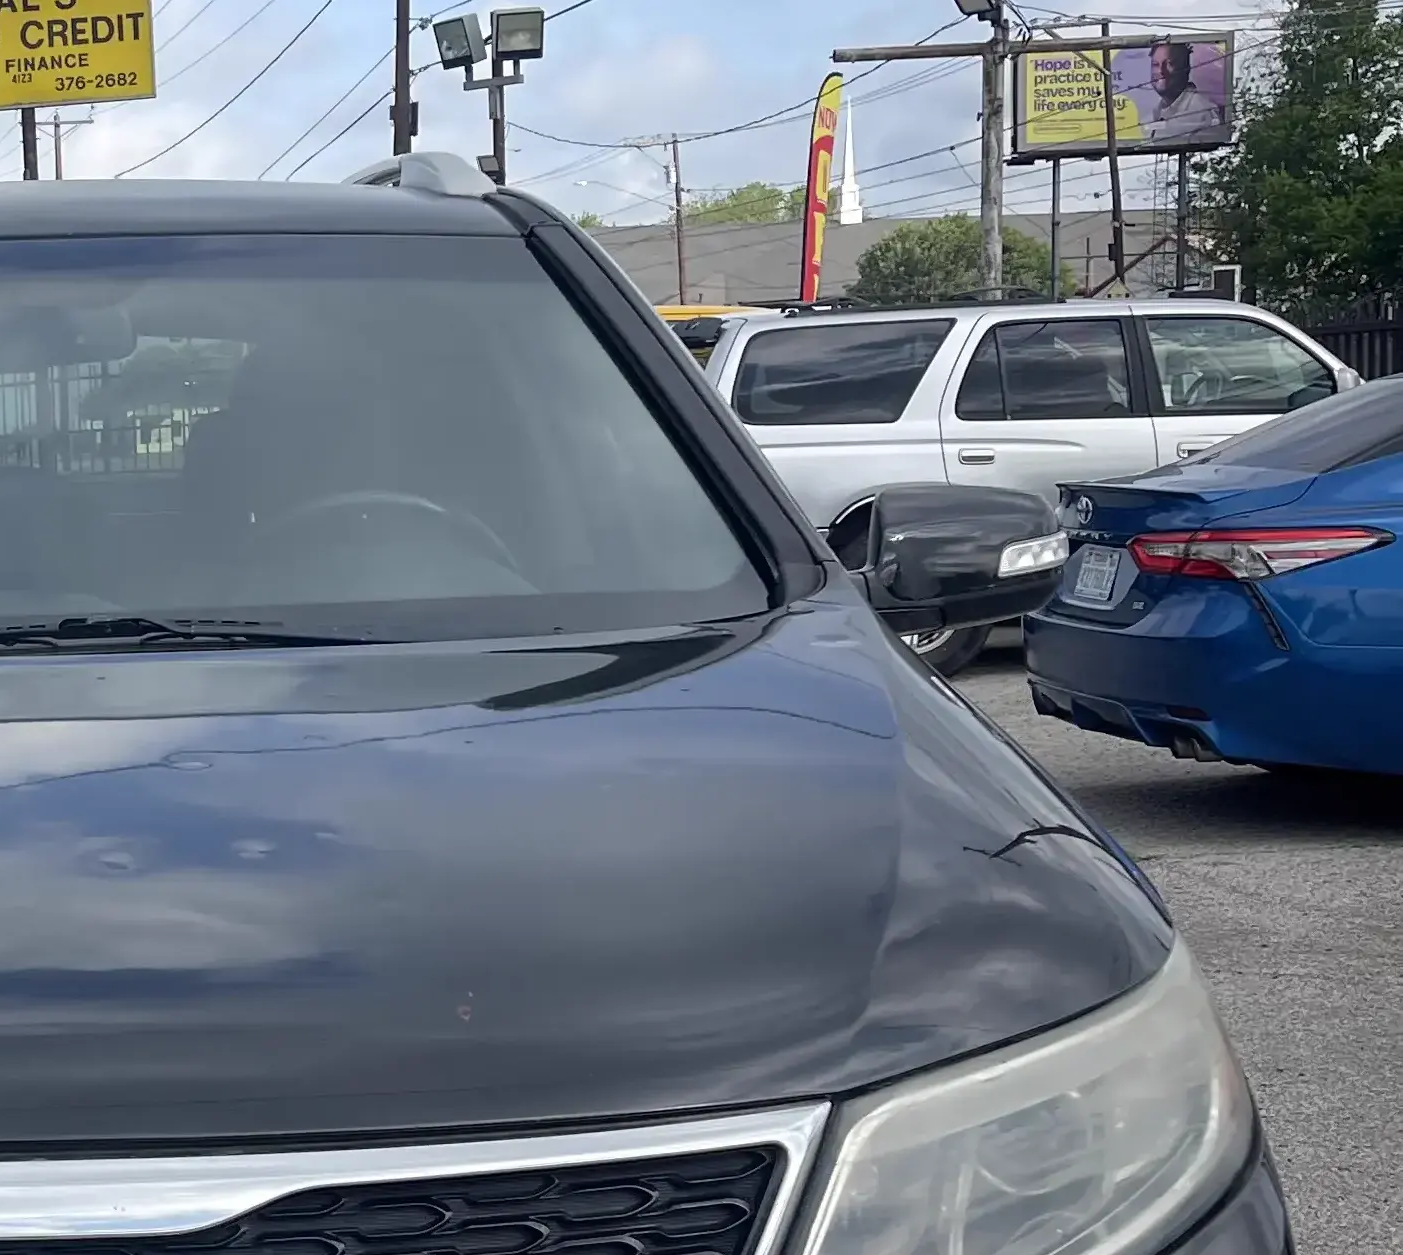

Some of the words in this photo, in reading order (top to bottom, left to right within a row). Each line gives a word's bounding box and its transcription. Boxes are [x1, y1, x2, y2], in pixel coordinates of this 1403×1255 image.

[20, 12, 144, 50] CREDIT
[5, 53, 89, 73] FINANCE
[11, 73, 33, 84] 4123
[54, 72, 138, 92] 376-2682
[1034, 71, 1091, 87] practice
[1034, 86, 1074, 98] saves
[1077, 86, 1100, 98] my
[1034, 99, 1055, 112] life
[1057, 98, 1097, 112] every
